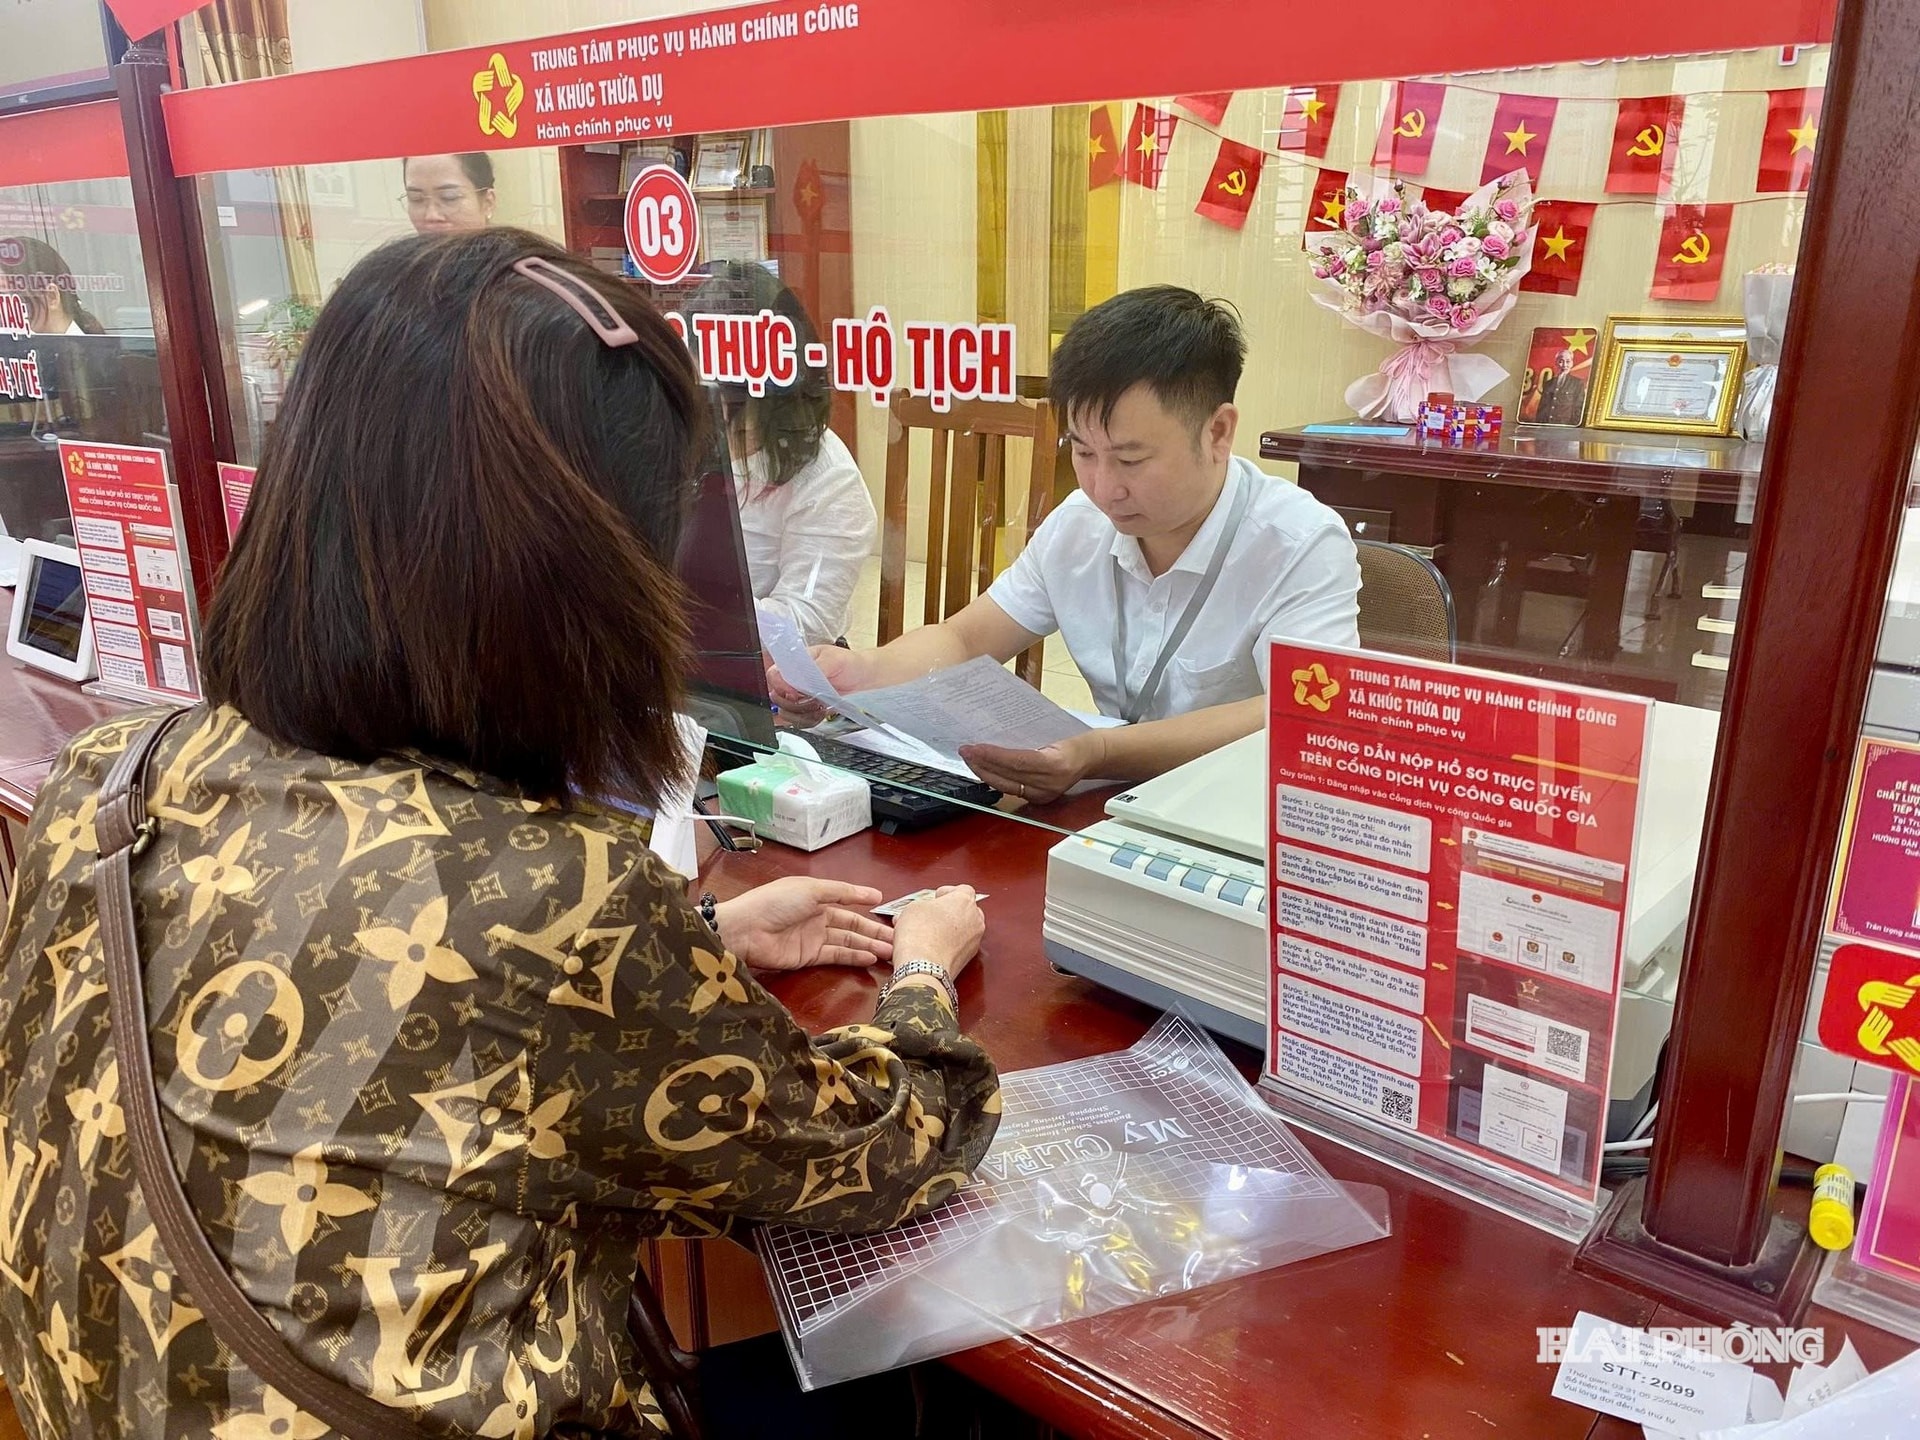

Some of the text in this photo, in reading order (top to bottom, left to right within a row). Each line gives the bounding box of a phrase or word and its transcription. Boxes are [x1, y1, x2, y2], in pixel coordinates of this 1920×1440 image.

[531, 3, 859, 72] TRUNG TÂM PHỤC VỤ HÀNH CHÍNH CÔNG
[535, 71, 663, 113] XÃ KHÚC THỪA DỤ
[537, 113, 673, 140] Hành chính phục vụ
[638, 196, 684, 257] 03
[696, 311, 796, 397] THỰC
[834, 308, 898, 406] HỘ
[905, 323, 1016, 412] TỊCH
[1349, 668, 1617, 726] TRUNG TÂM PHỤC VỤ HÀNH CHÍNH CÔNG
[1349, 686, 1460, 725] XÃ KHÚC THỪA DỤ
[1348, 707, 1465, 741] Hành chính phục vụ
[1300, 748, 1598, 827] TRÊN CỔNG DỊCH VỤ CÔNG QUỐC GIA
[1307, 730, 1591, 804] HƯỚNG DẪN NỘP HỒ SƠ TRỰC TUYẾN
[1280, 767, 1295, 780] Quy
[1297, 771, 1315, 782] trình
[1327, 778, 1347, 792] Đăng
[1349, 783, 1370, 797] nhập
[1371, 789, 1386, 799] vào
[1389, 791, 1411, 807] Cổng
[1412, 798, 1431, 811] dịch
[1433, 804, 1444, 814] vụ
[1446, 806, 1469, 820] công
[1471, 810, 1496, 825] Quốc
[1498, 817, 1512, 830] gia
[1281, 794, 1302, 805] Bước
[1305, 800, 1311, 808] 1:
[1313, 802, 1333, 814] Công
[1336, 807, 1350, 817] dân
[1367, 815, 1385, 826] trình
[1388, 820, 1410, 834] duyệt
[1122, 1117, 1193, 1146] My
[1649, 1376, 1696, 1398] 2099
